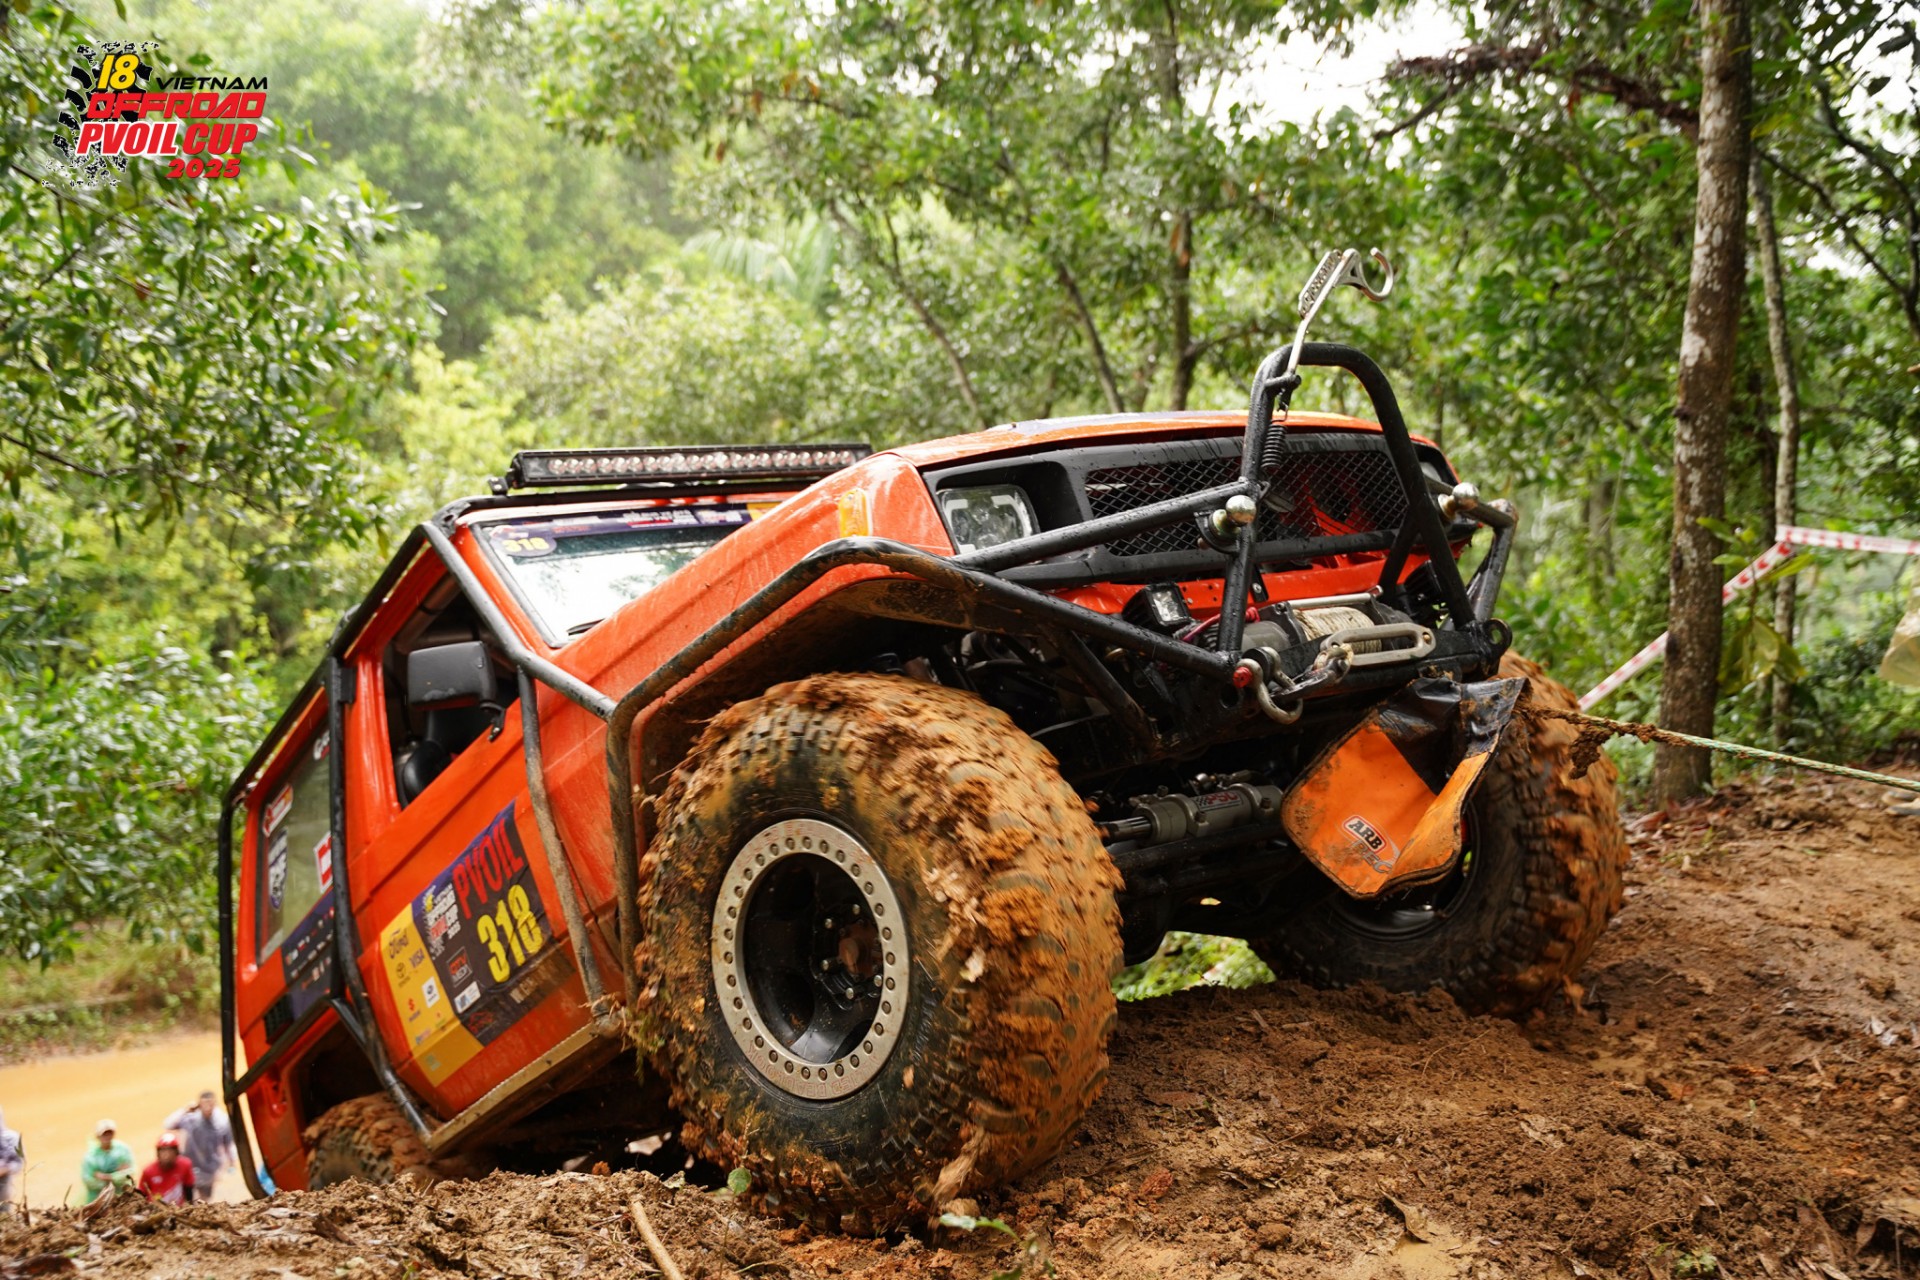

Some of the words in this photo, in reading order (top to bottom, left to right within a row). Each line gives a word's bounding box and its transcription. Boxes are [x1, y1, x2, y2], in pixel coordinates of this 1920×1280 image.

[452, 818, 524, 919] PVOIL
[1348, 820, 1383, 849] ARB
[477, 884, 544, 983] 318
